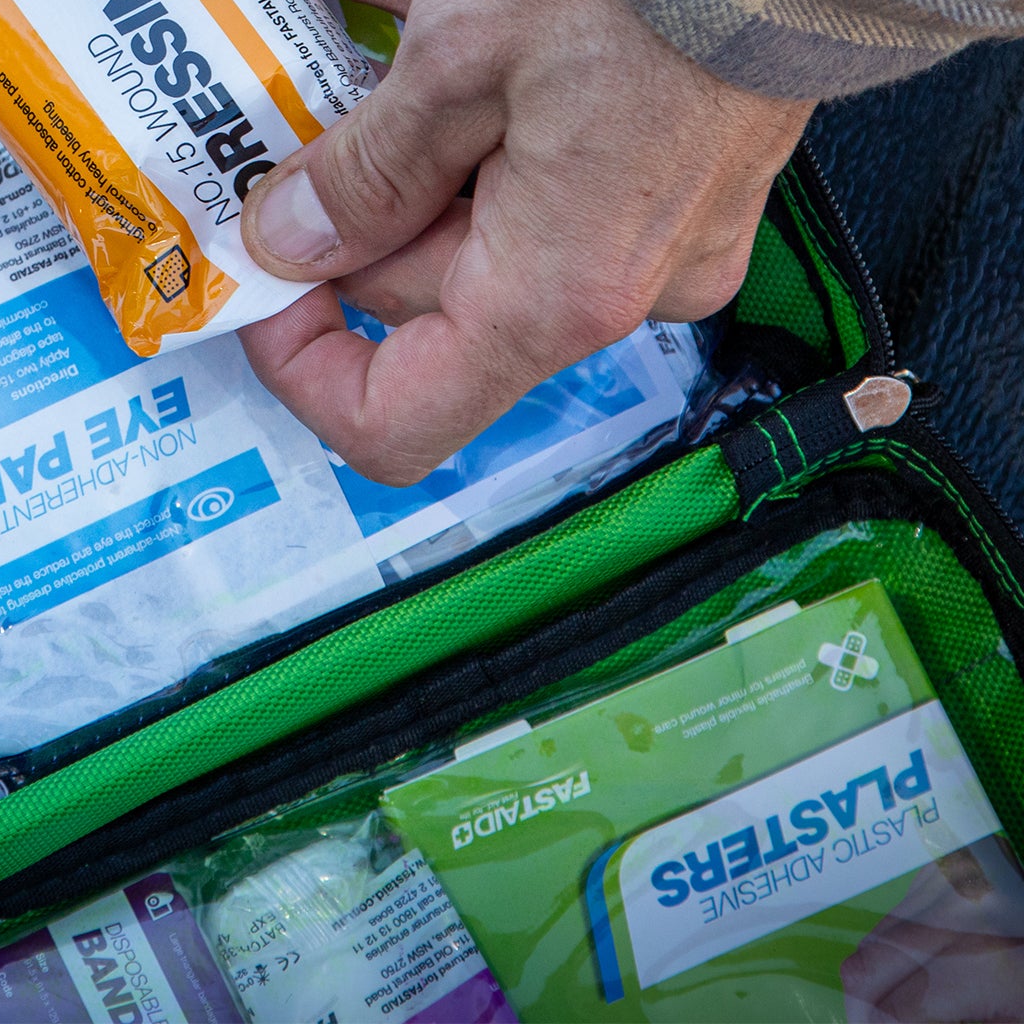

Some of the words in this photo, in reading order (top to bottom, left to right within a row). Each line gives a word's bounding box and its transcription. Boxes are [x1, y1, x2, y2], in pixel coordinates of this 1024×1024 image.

[291, 37, 313, 61] for
[296, 11, 341, 64] Bathurst
[85, 31, 182, 143] WOUND
[9, 93, 62, 154] absorbent
[35, 97, 86, 154] bleeding.
[52, 149, 89, 191] cotton
[75, 147, 112, 188] heavy
[167, 138, 240, 227] NO.15
[86, 187, 146, 245] ightweight
[104, 178, 148, 228] control
[2, 209, 50, 236] enquiries
[22, 235, 67, 262] Bathurst
[51, 250, 69, 263] for
[7, 256, 53, 282] FASTAID
[35, 328, 64, 350] tape
[13, 361, 40, 381] two
[36, 343, 73, 370] Apply
[8, 361, 80, 404] Directions
[81, 377, 193, 457] EYE
[2, 423, 197, 535] NON-ADHERENT
[132, 507, 173, 536] protect
[104, 521, 182, 567] Non-adherent
[30, 555, 72, 583] reduce
[50, 556, 107, 592] protective
[5, 581, 53, 613] dressing
[762, 656, 809, 687] plasters
[714, 685, 749, 709] minor
[754, 672, 816, 708] Breathable
[650, 715, 680, 738] care.
[677, 699, 717, 726] wound
[716, 698, 757, 726] flexible
[679, 715, 719, 743] plastic
[476, 772, 591, 837] FASTAID
[652, 750, 932, 908] PLASTERS
[833, 798, 941, 864] PLASTIC
[391, 887, 421, 911] 4728
[701, 849, 825, 924] ADHESIVE
[388, 905, 418, 930] 1800
[415, 893, 438, 913] call
[362, 926, 413, 964] enquiries
[404, 939, 434, 964] NSW
[431, 942, 455, 963] Old
[34, 951, 52, 974] Size
[69, 923, 147, 1024] BAND
[378, 956, 408, 980] 2750
[390, 956, 436, 990] Bathurst
[362, 982, 394, 1008] Road
[378, 981, 425, 1015] FASTAID
